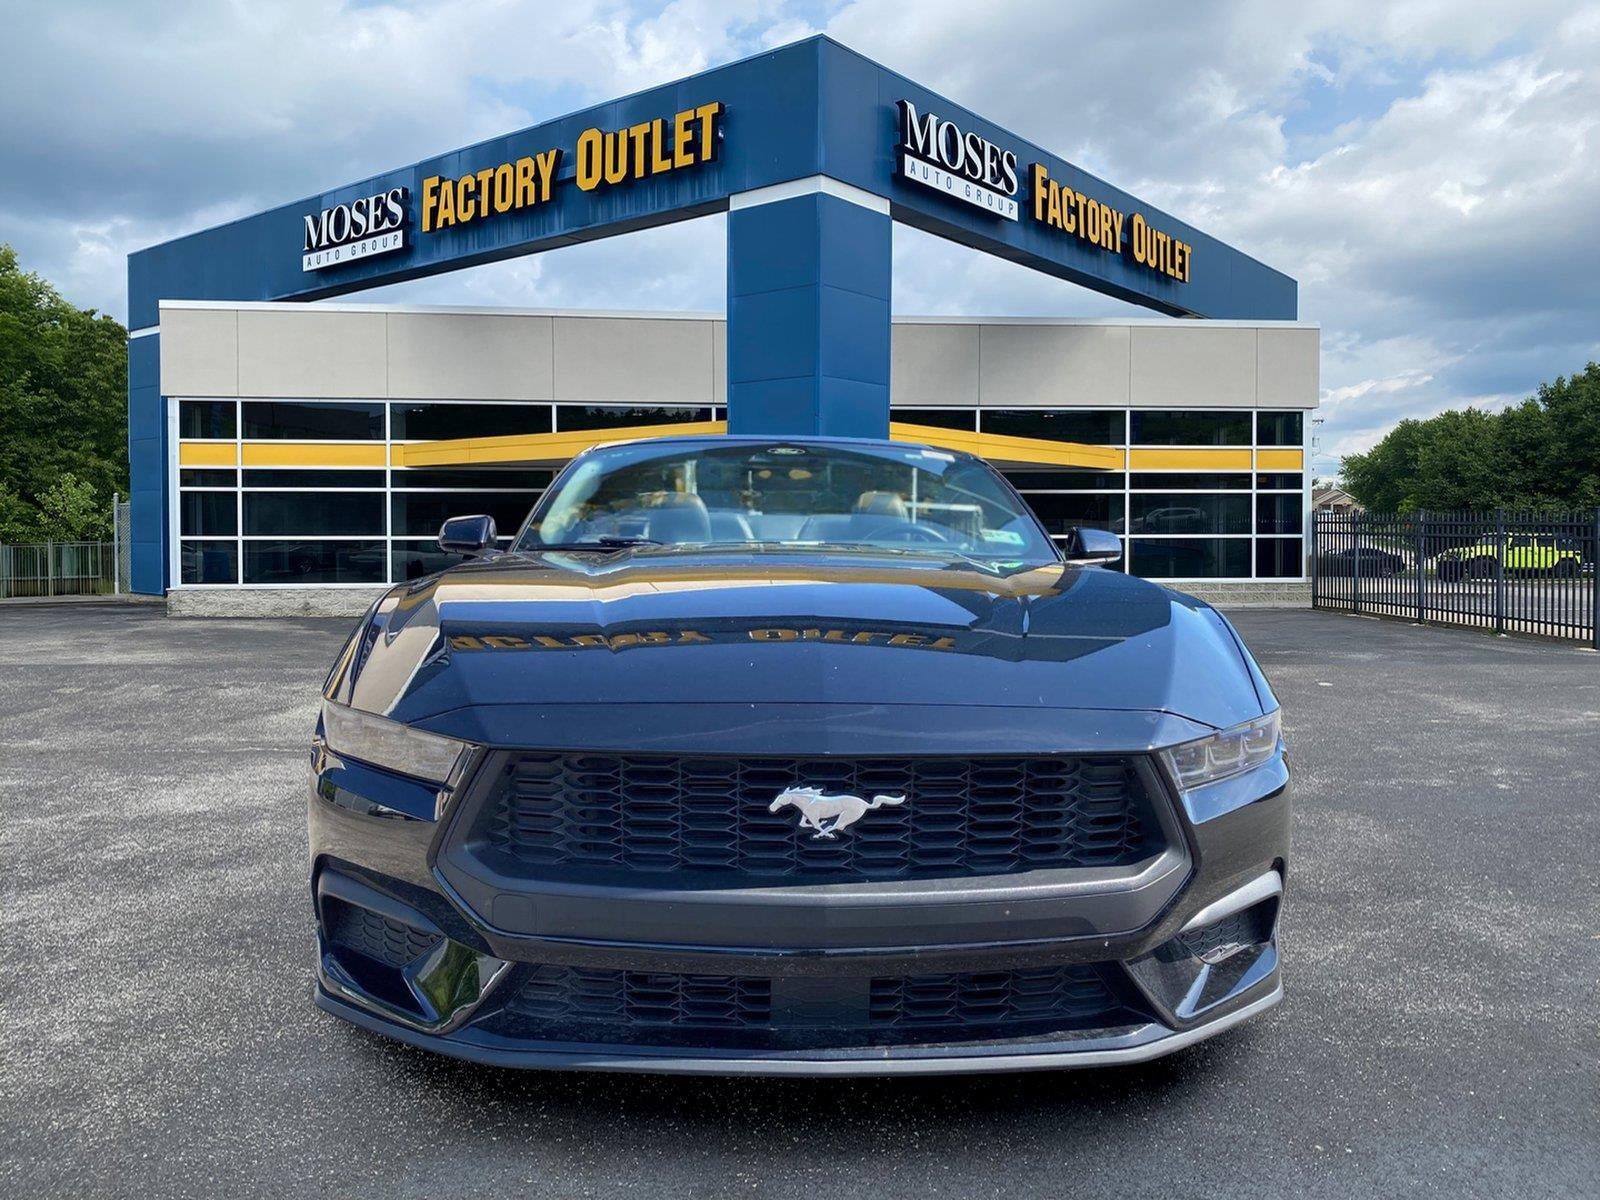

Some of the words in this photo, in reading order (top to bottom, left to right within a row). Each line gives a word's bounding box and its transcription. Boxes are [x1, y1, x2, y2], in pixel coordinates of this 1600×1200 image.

[422, 149, 558, 233] FACTORY
[576, 101, 720, 191] OUTLET
[904, 99, 1018, 196] MOSES
[910, 161, 952, 190] AUTO
[965, 184, 1014, 214] GROUP
[303, 187, 403, 251] MOSES
[307, 249, 340, 267] AUTO
[351, 234, 399, 256] GROUP
[1034, 162, 1124, 253] FACTORY
[1132, 212, 1192, 283] OUTLET
